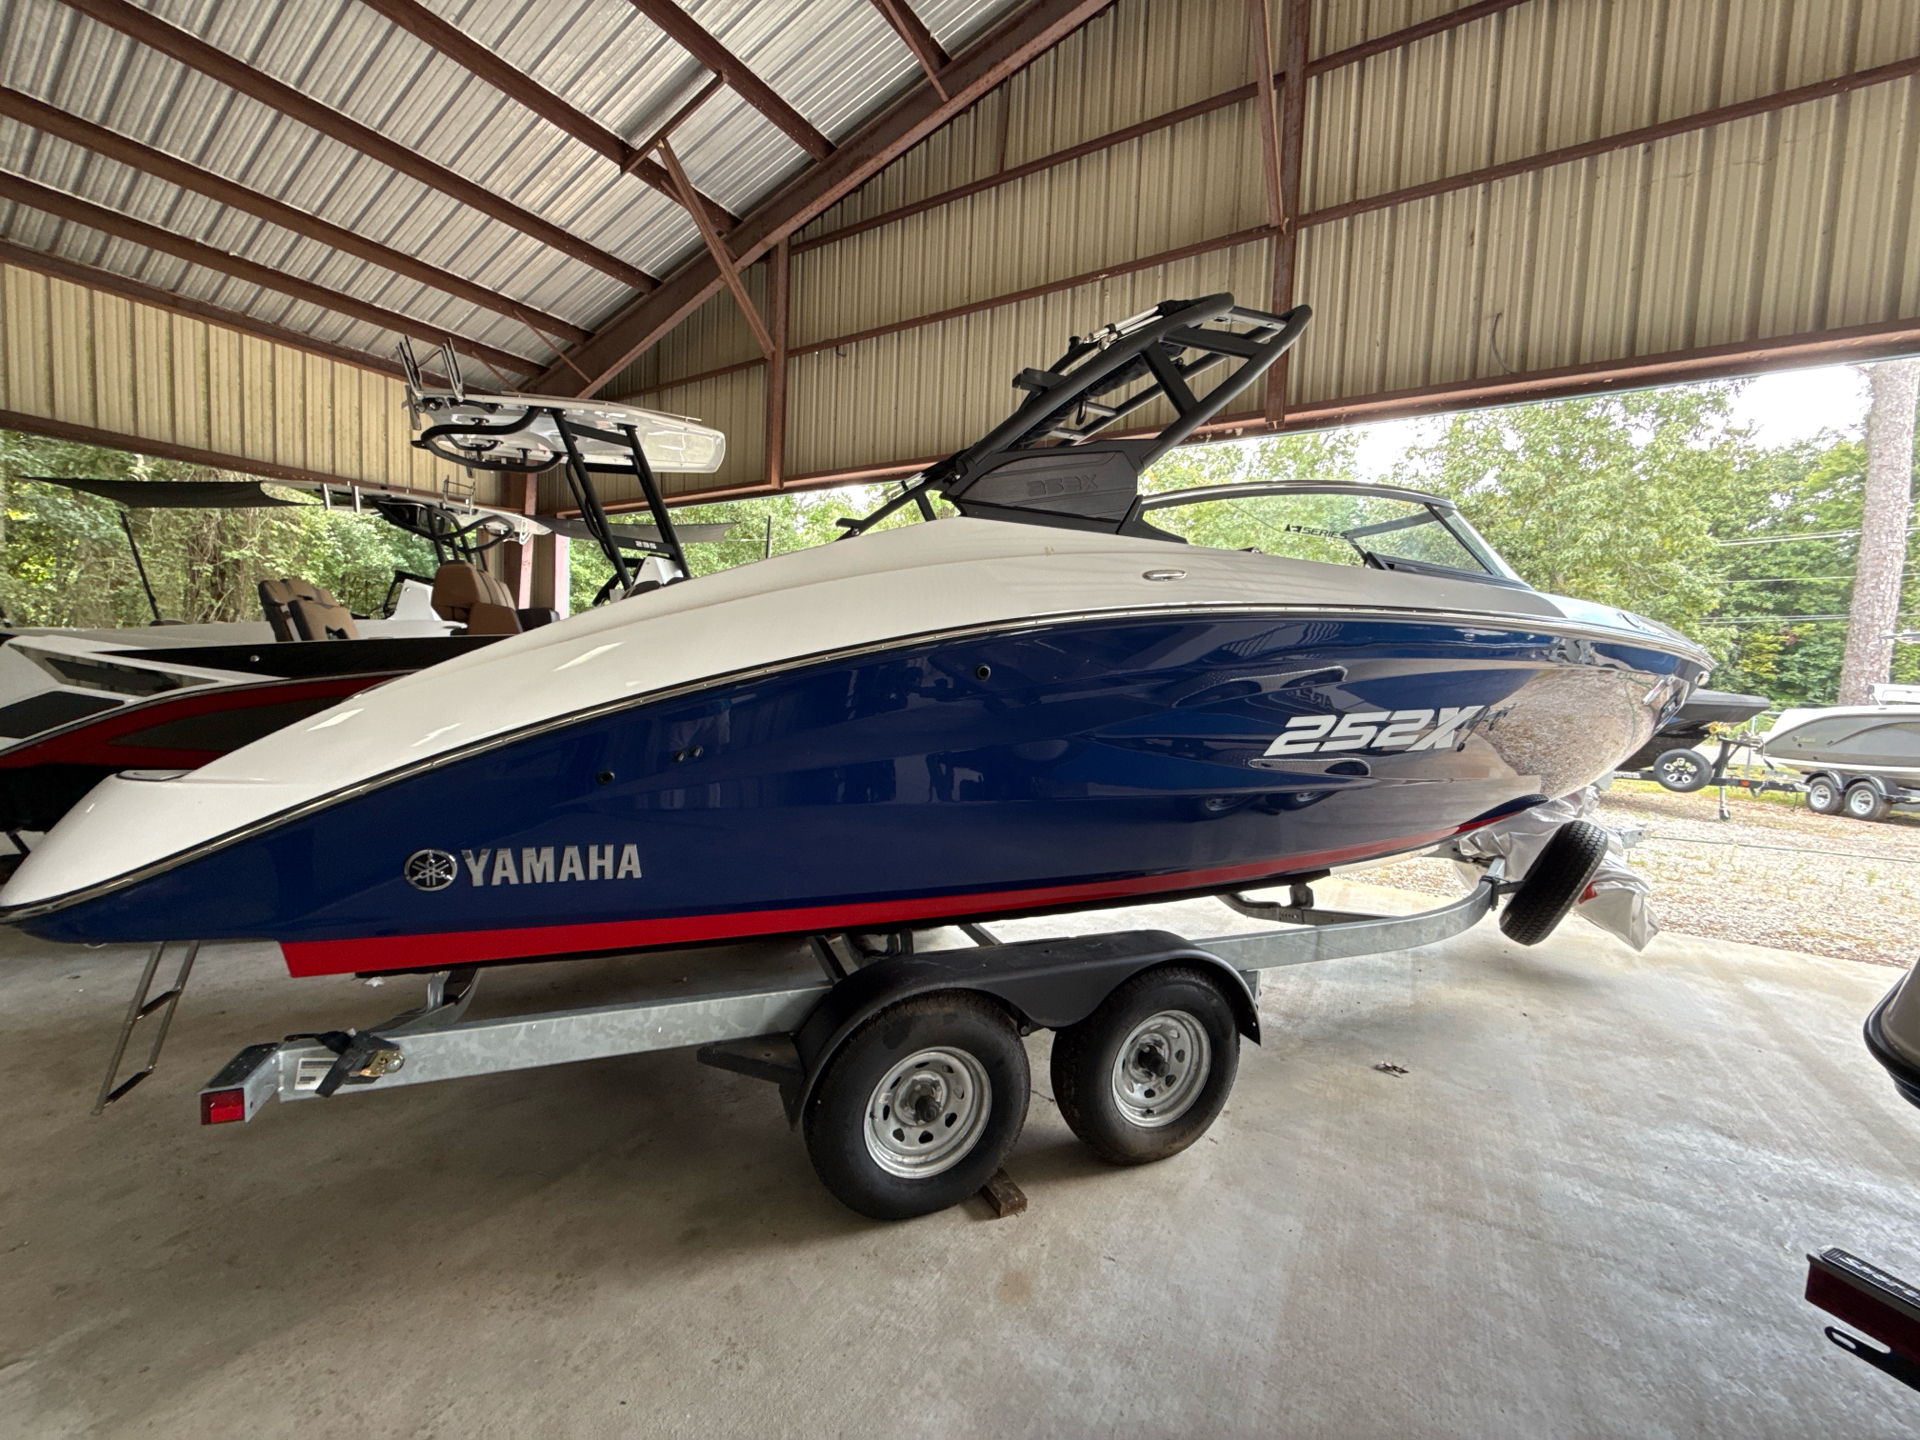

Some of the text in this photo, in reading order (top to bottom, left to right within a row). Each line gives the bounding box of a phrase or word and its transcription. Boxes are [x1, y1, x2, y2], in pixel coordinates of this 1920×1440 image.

[1302, 526, 1348, 539] SERIES
[1263, 705, 1485, 756] 252X
[461, 844, 642, 887] YAMAHA
